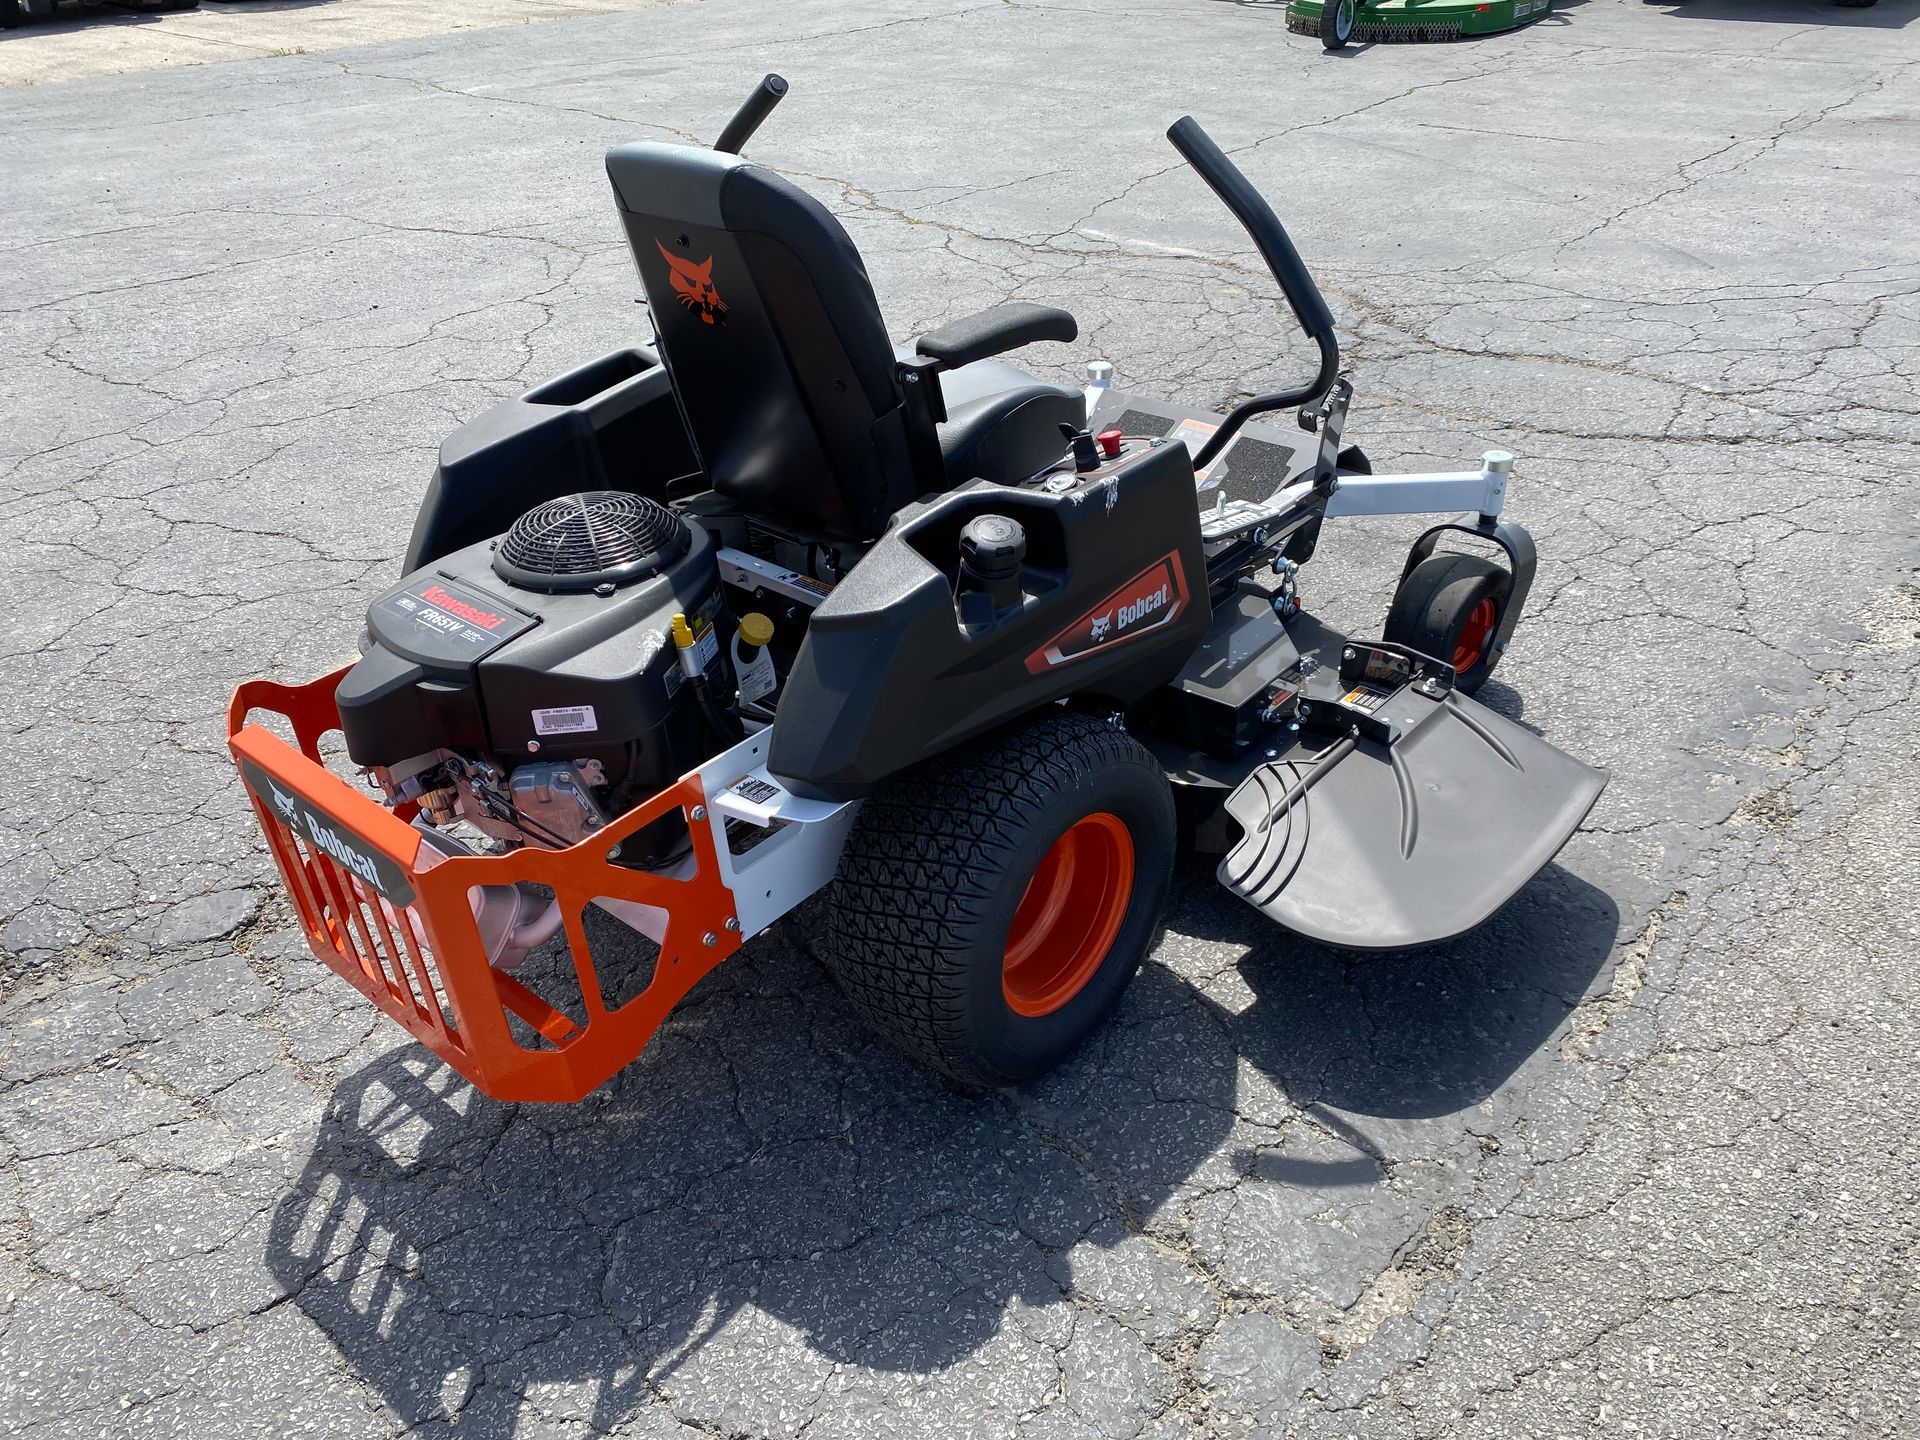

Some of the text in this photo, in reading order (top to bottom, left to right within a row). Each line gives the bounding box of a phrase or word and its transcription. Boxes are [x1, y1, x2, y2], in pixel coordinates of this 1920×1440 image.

[417, 608, 465, 631] FR651V
[419, 586, 506, 630] Kawasaki
[1117, 583, 1168, 630] Bobcat
[303, 811, 385, 892] Bobcat
